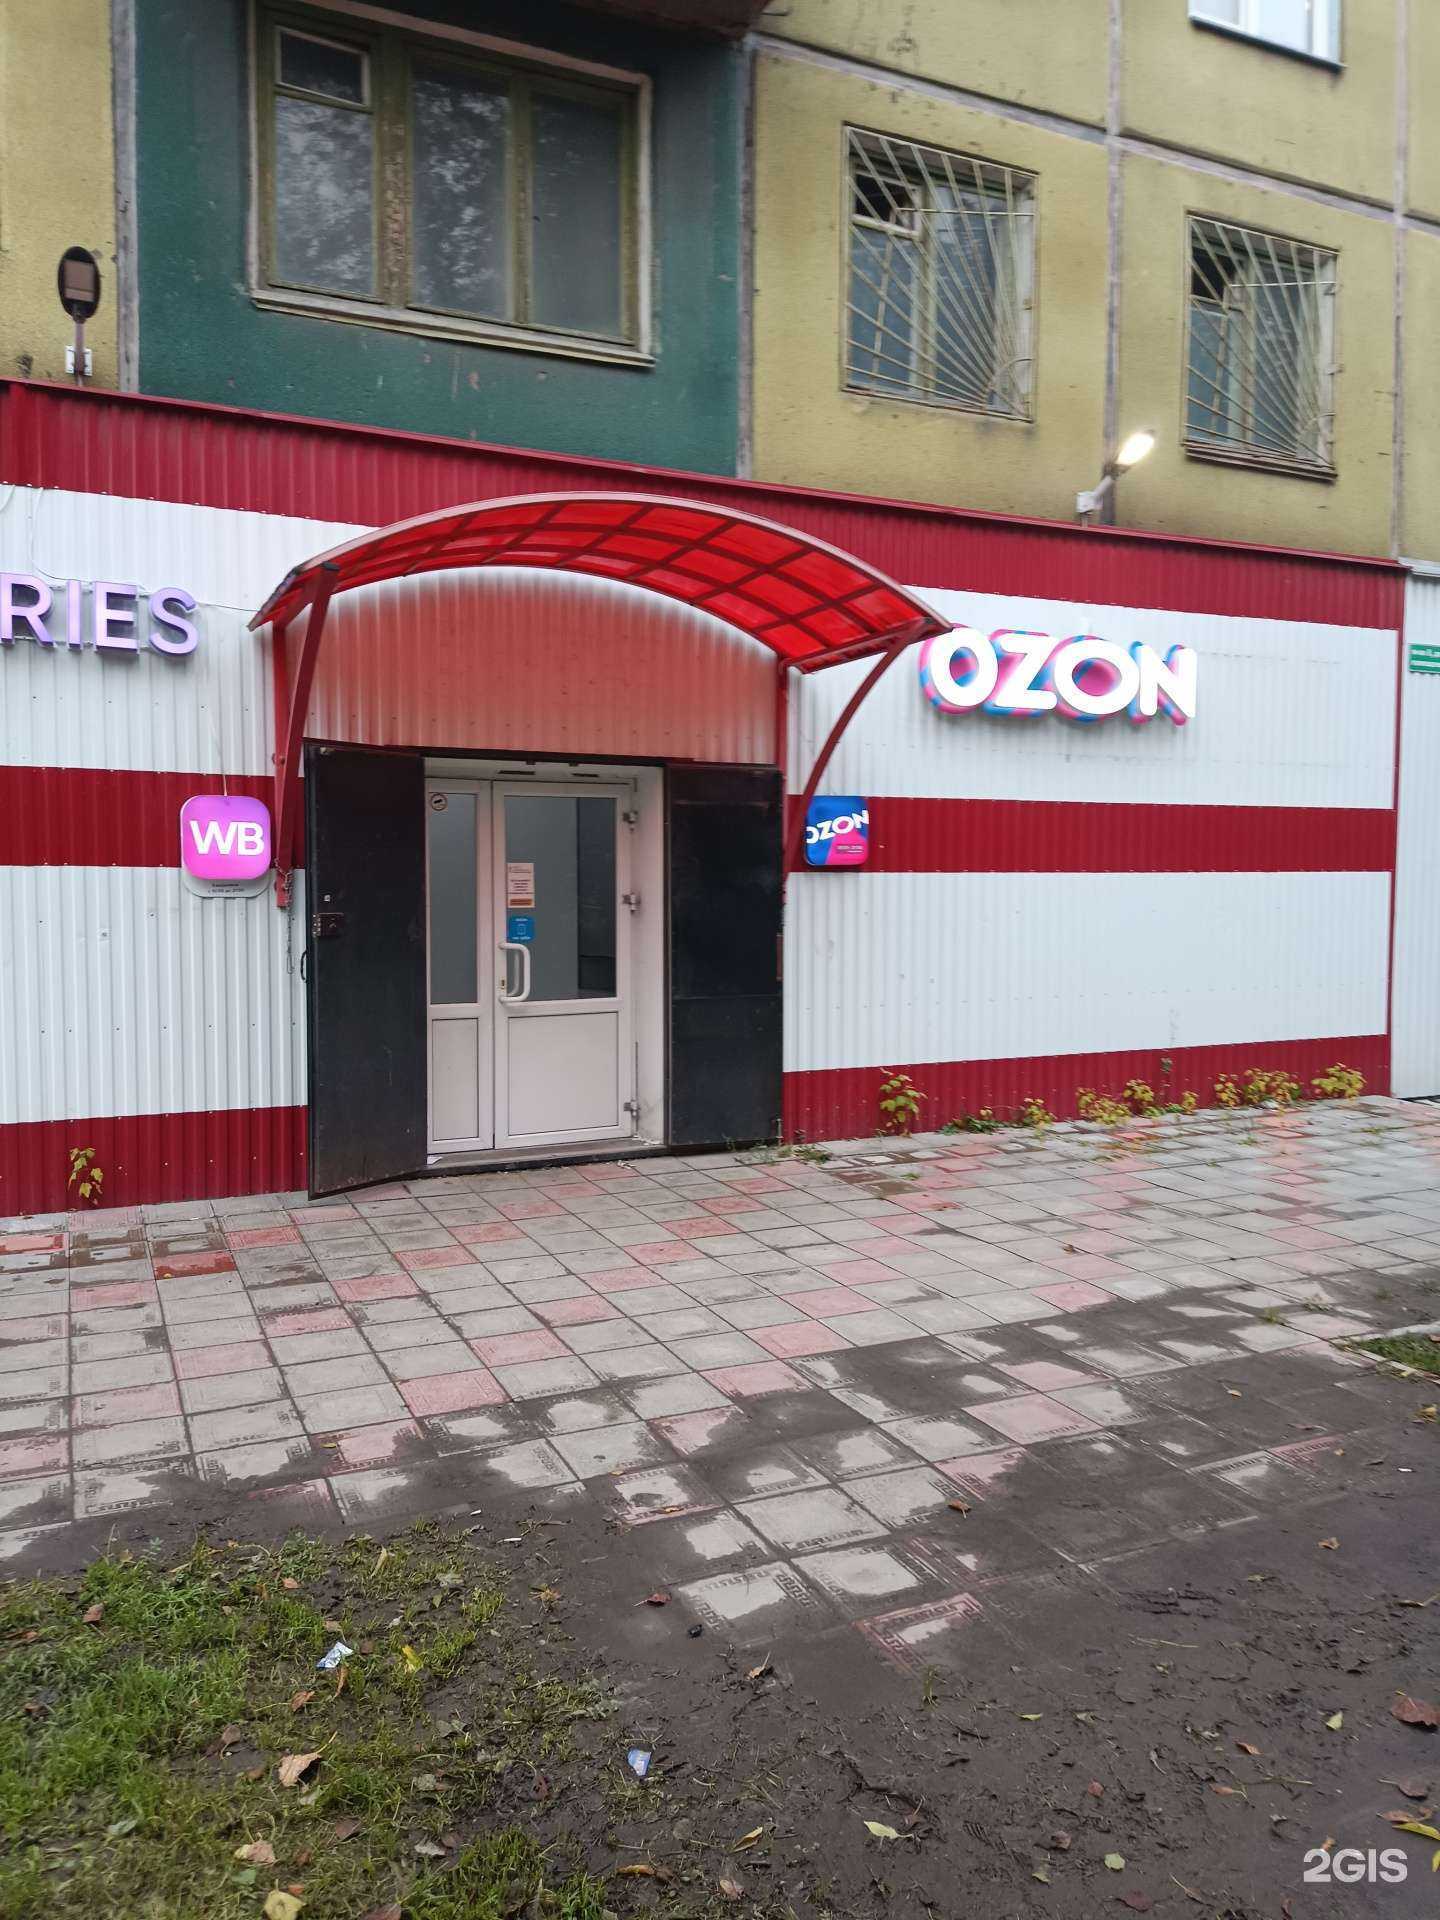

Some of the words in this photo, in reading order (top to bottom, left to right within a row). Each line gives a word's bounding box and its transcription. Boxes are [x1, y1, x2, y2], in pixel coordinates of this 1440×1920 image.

[0, 572, 199, 656] RIES
[920, 625, 1198, 724] OZON
[189, 820, 265, 856] WB
